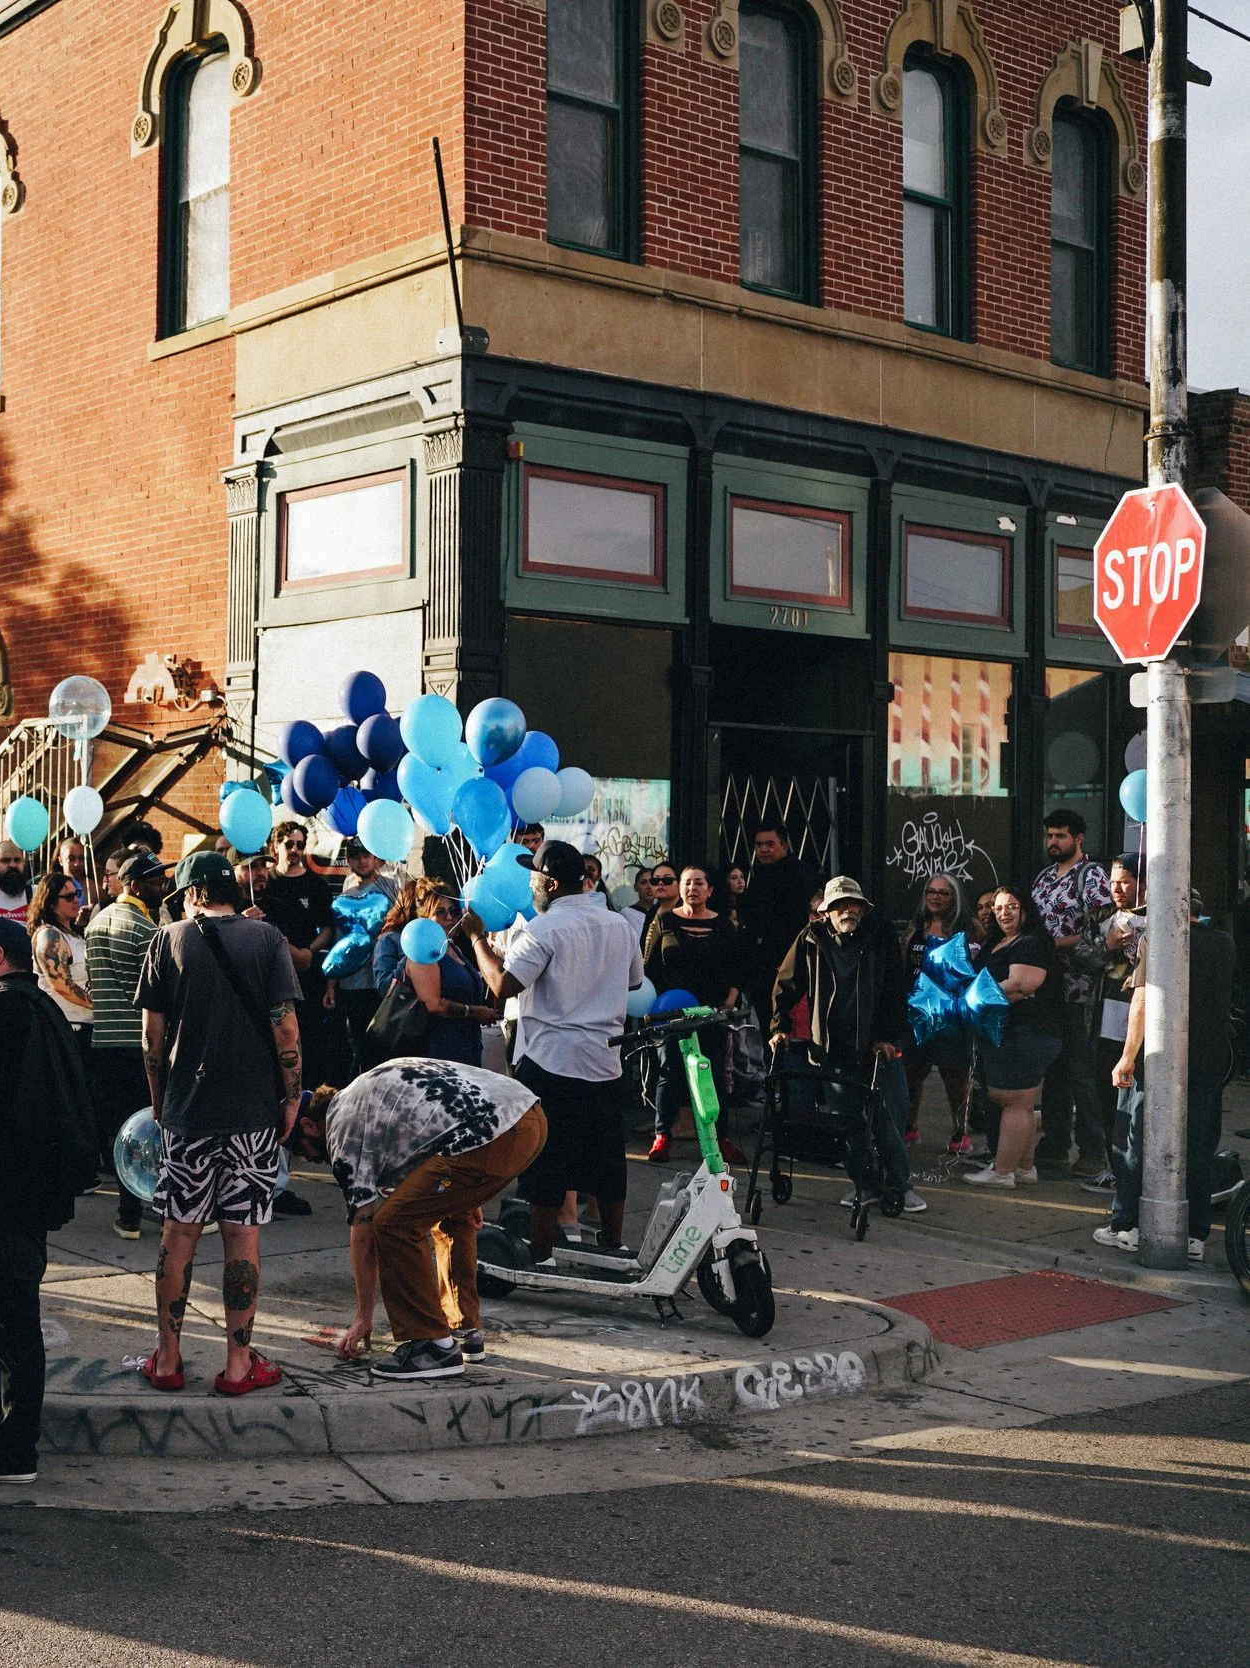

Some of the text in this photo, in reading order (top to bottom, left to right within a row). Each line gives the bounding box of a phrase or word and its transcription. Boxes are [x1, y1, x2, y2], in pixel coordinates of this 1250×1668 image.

[1102, 537, 1196, 610] STOP
[770, 605, 809, 629] 2701
[912, 944, 925, 952] SER
